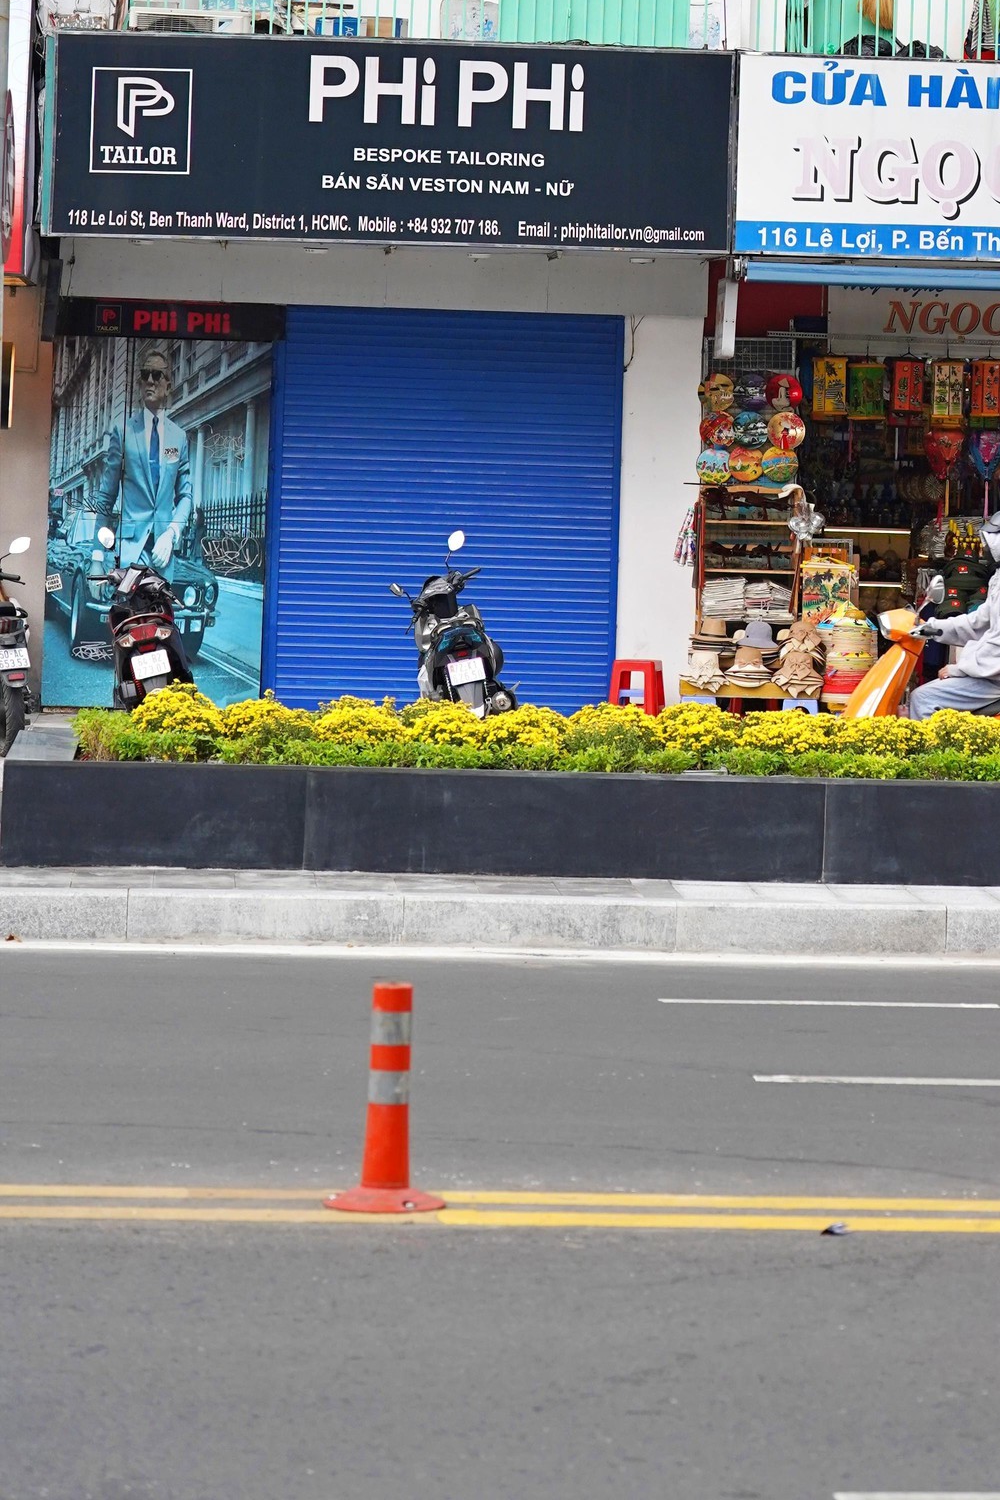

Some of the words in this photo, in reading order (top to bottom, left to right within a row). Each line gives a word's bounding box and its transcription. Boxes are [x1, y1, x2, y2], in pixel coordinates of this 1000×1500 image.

[772, 61, 886, 106] CỬA
[101, 146, 177, 164] TAILOR
[354, 148, 441, 163] BESPOKE
[447, 151, 544, 167] TAILORING
[322, 172, 360, 189] BÁN
[366, 174, 403, 190] SẴN
[409, 178, 482, 193] VESTON
[489, 181, 529, 194] NAM
[547, 180, 574, 196] NỮ
[69, 209, 87, 225] 118
[91, 210, 105, 225] Le
[109, 211, 127, 226] Loi
[130, 211, 145, 229] St,
[150, 211, 172, 227] Ben
[176, 212, 210, 227] Thanh
[213, 212, 249, 231] Ward,
[253, 214, 295, 229] District
[299, 215, 307, 232] 1,
[312, 215, 351, 231] HCMC.
[358, 216, 396, 232] Mobile
[407, 218, 428, 233] +84
[431, 218, 451, 233] 932
[455, 219, 474, 234] 707
[478, 220, 501, 235] 186.
[518, 221, 550, 237] Email
[561, 223, 704, 243] phiphitailor.vn@gmail.com
[759, 228, 796, 246] 116
[806, 228, 832, 247] Lê
[842, 229, 882, 252] Lợi,
[893, 231, 909, 248] P.
[920, 229, 963, 250] Bến
